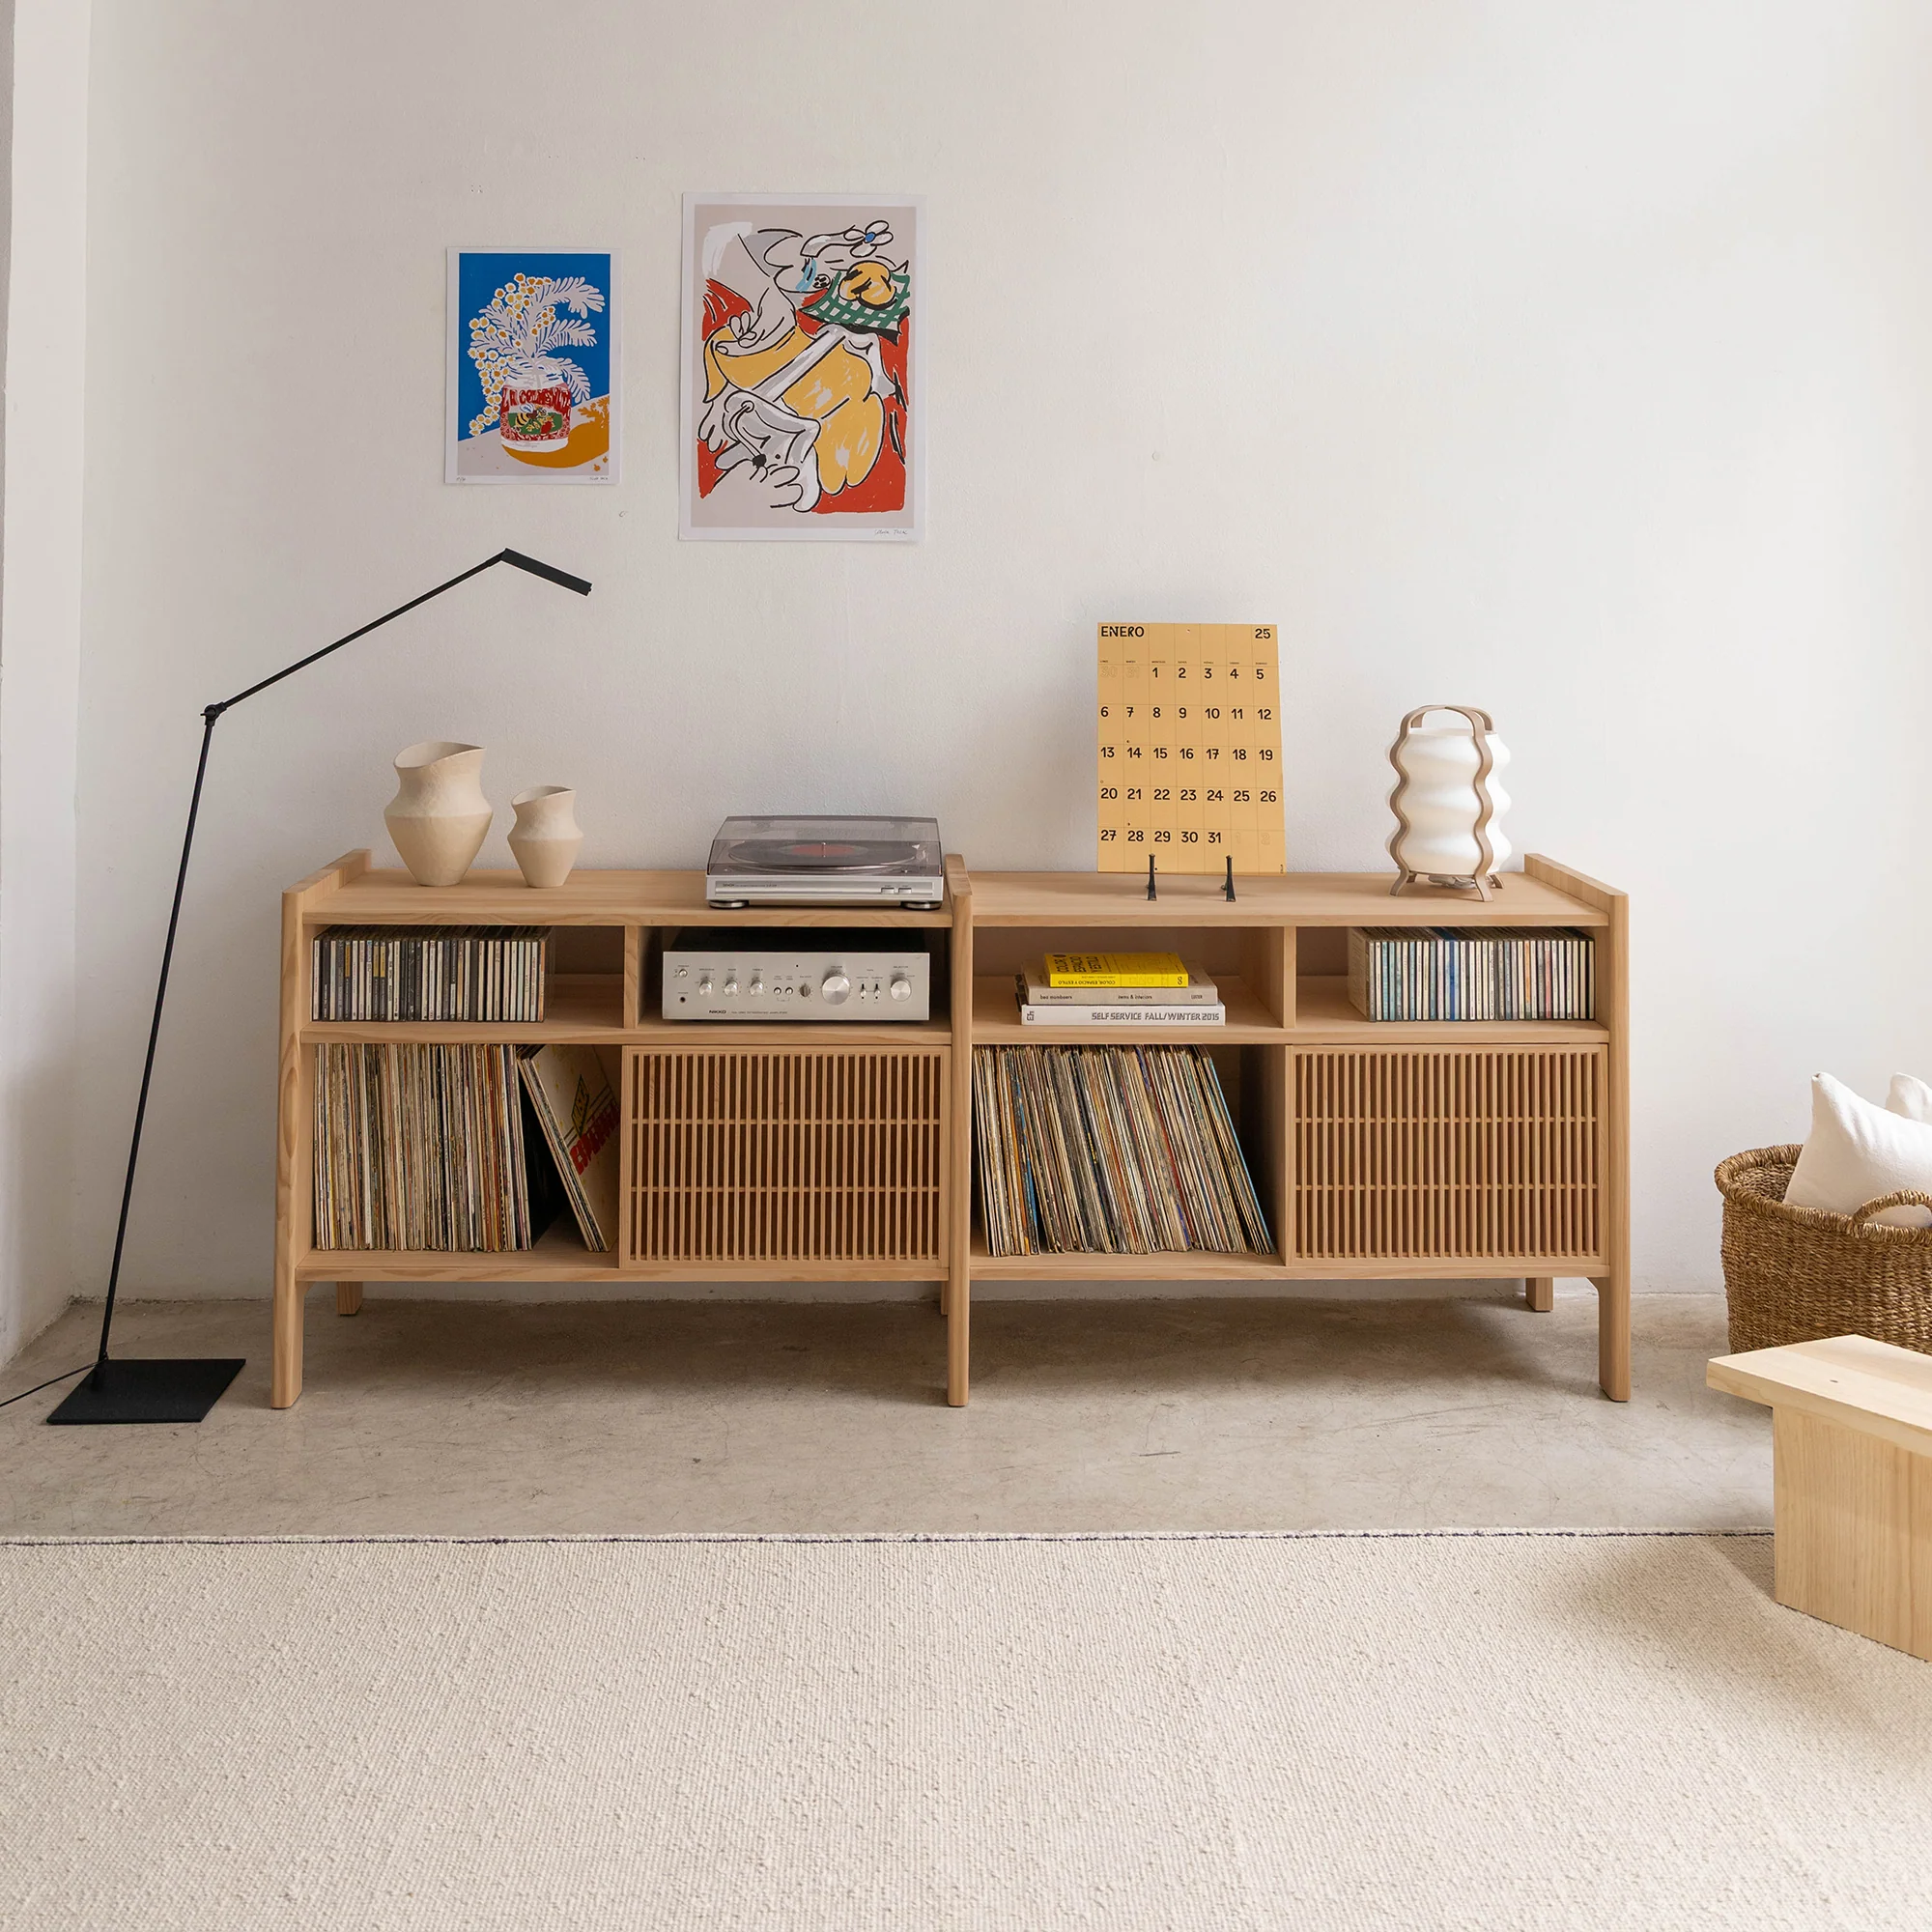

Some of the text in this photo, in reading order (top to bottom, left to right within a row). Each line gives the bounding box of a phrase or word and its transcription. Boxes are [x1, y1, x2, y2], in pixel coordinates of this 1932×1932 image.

[1100, 626, 1145, 638] ENERO
[1255, 628, 1271, 639] 25
[1151, 667, 1158, 678] 1
[1178, 667, 1187, 679] 2
[1204, 668, 1212, 679] 3
[1229, 668, 1239, 679] 4
[1256, 668, 1264, 680] 5
[1100, 706, 1272, 721] 6 7 8 9 10 11 12
[1100, 747, 1273, 761] 13 14 15 16 17 18 19
[1100, 787, 1277, 803] 20 21 22 23 24 25 26
[1100, 830, 1117, 841] 27
[1127, 830, 1145, 842] 28
[1153, 831, 1171, 843] 29
[1180, 831, 1199, 843] 30
[1208, 832, 1222, 844] 31
[1145, 1012, 1201, 1021] FALL/WINTER
[1202, 1012, 1220, 1021] 2015
